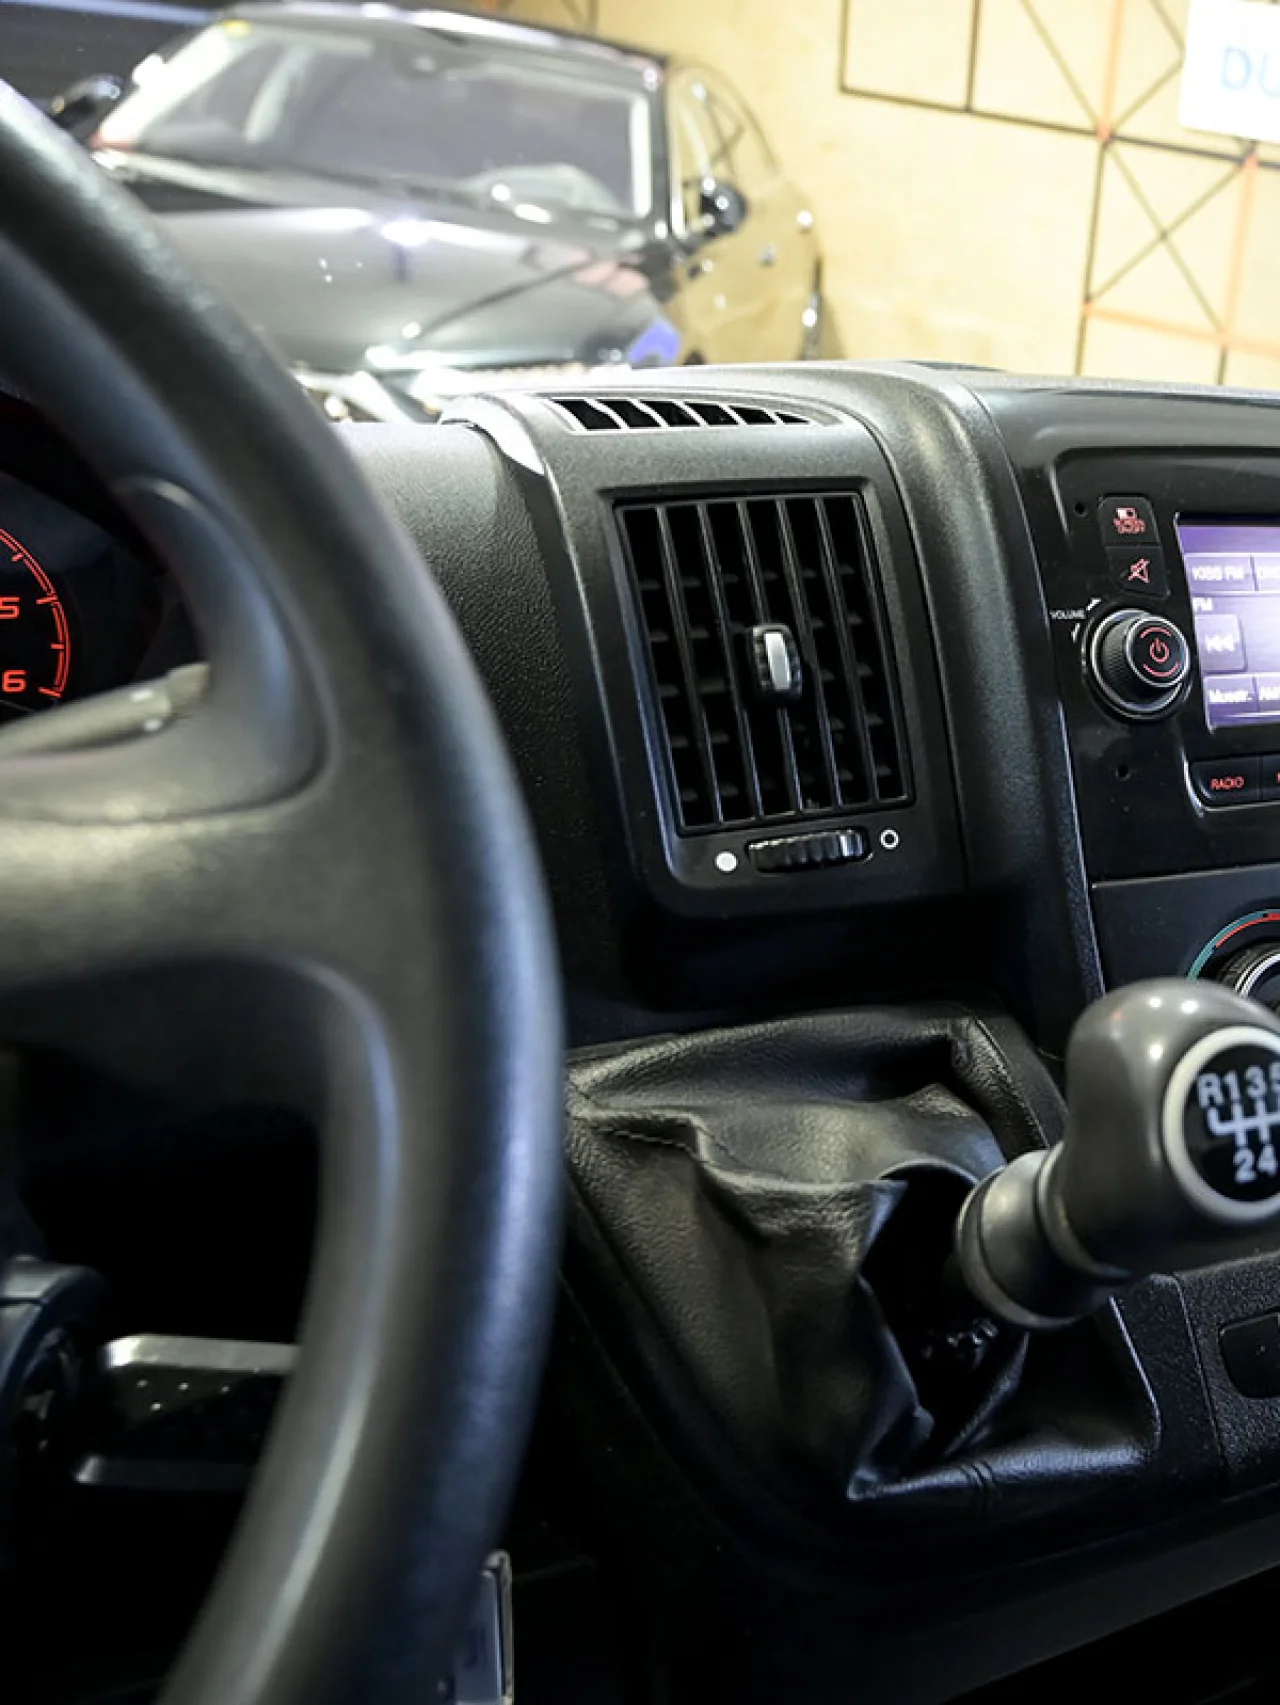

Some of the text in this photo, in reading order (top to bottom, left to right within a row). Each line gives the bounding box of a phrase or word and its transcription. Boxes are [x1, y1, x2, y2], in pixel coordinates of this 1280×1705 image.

[0, 596, 20, 619] 5
[1049, 609, 1086, 620] VOLUME
[2, 669, 27, 693] 6
[1211, 776, 1245, 790] RADIO
